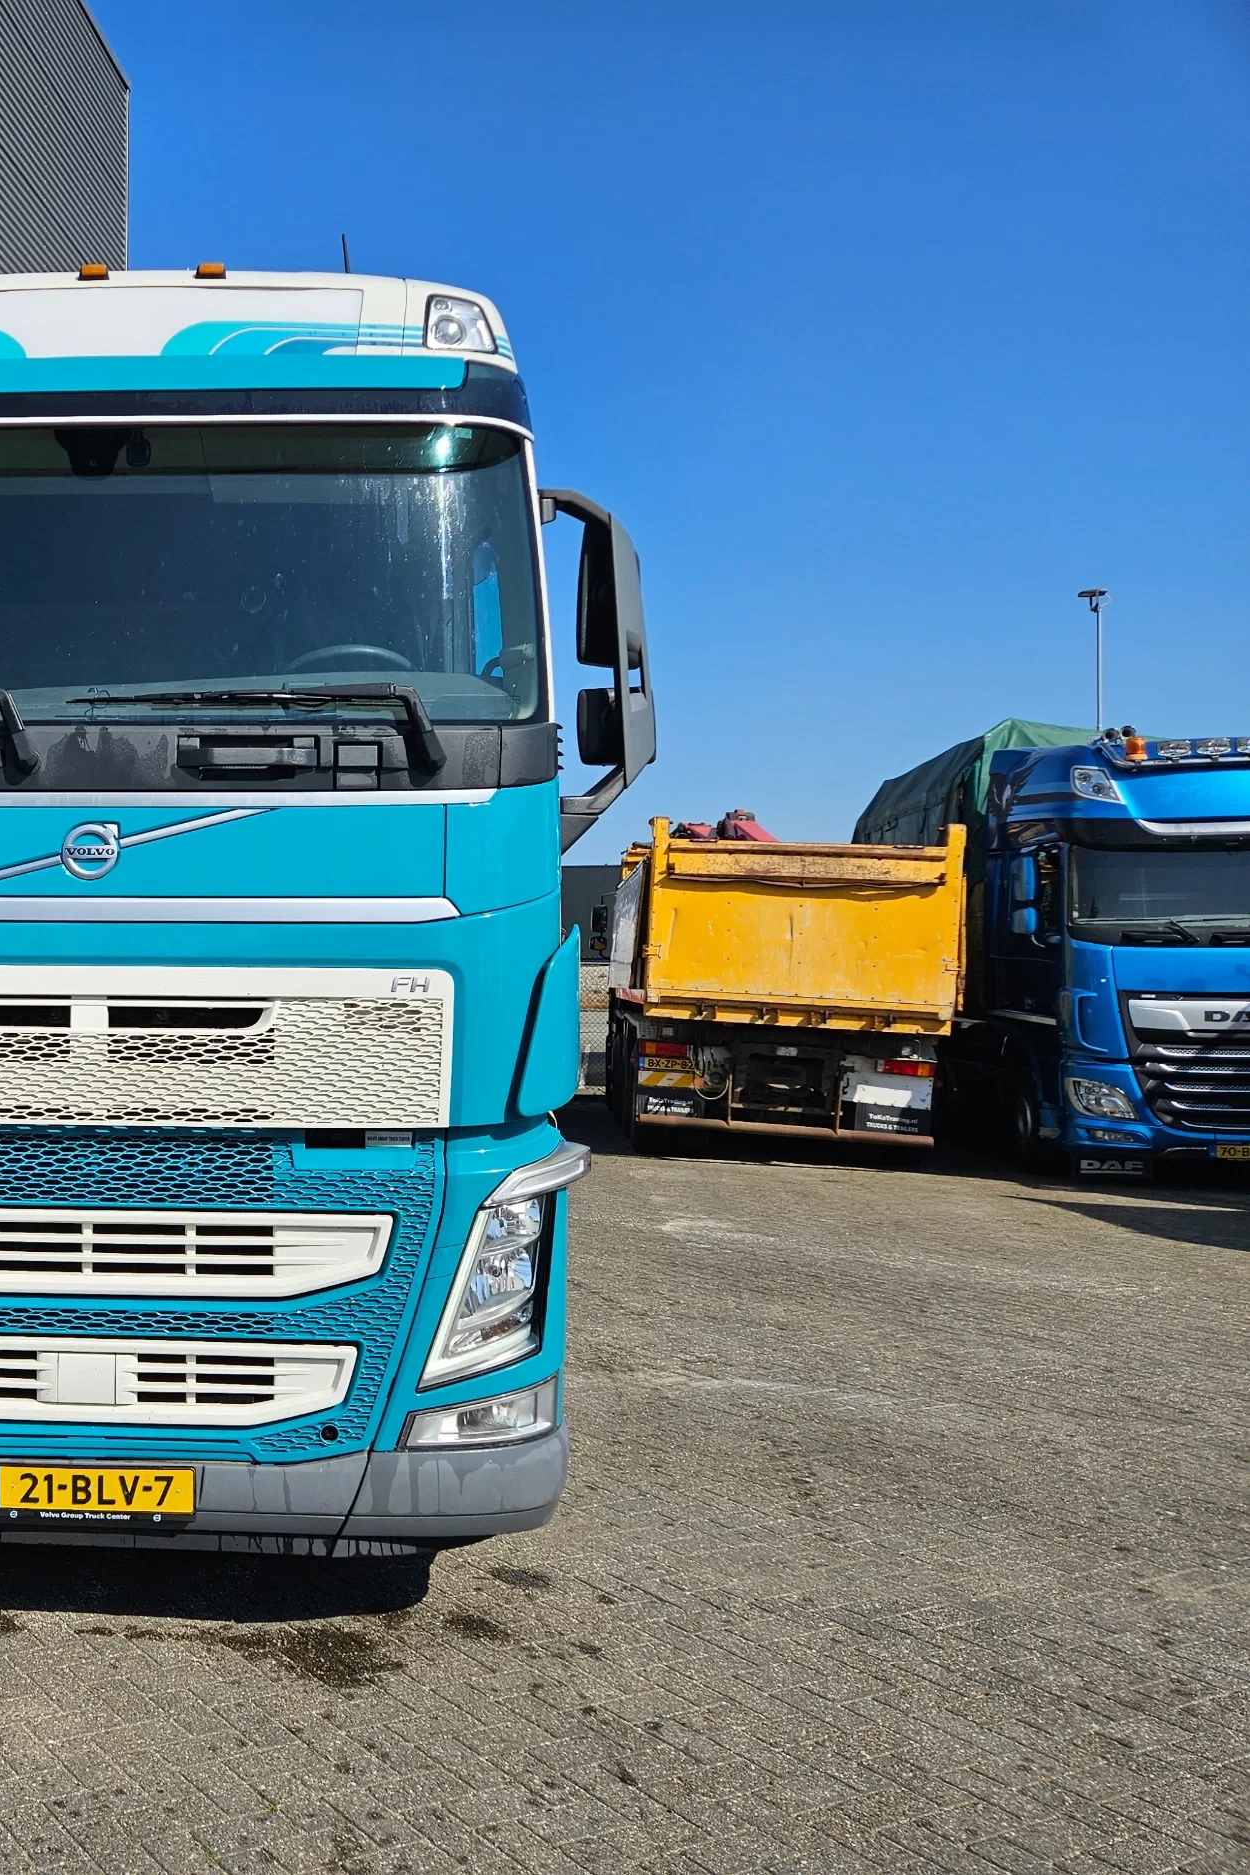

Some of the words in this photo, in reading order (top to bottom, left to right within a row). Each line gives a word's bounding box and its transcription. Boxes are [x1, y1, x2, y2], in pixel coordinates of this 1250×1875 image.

[65, 847, 115, 856] VOLVO
[390, 976, 431, 992] FH
[1081, 1160, 1143, 1170] DAF
[19, 1472, 175, 1507] 21-BLV-7
